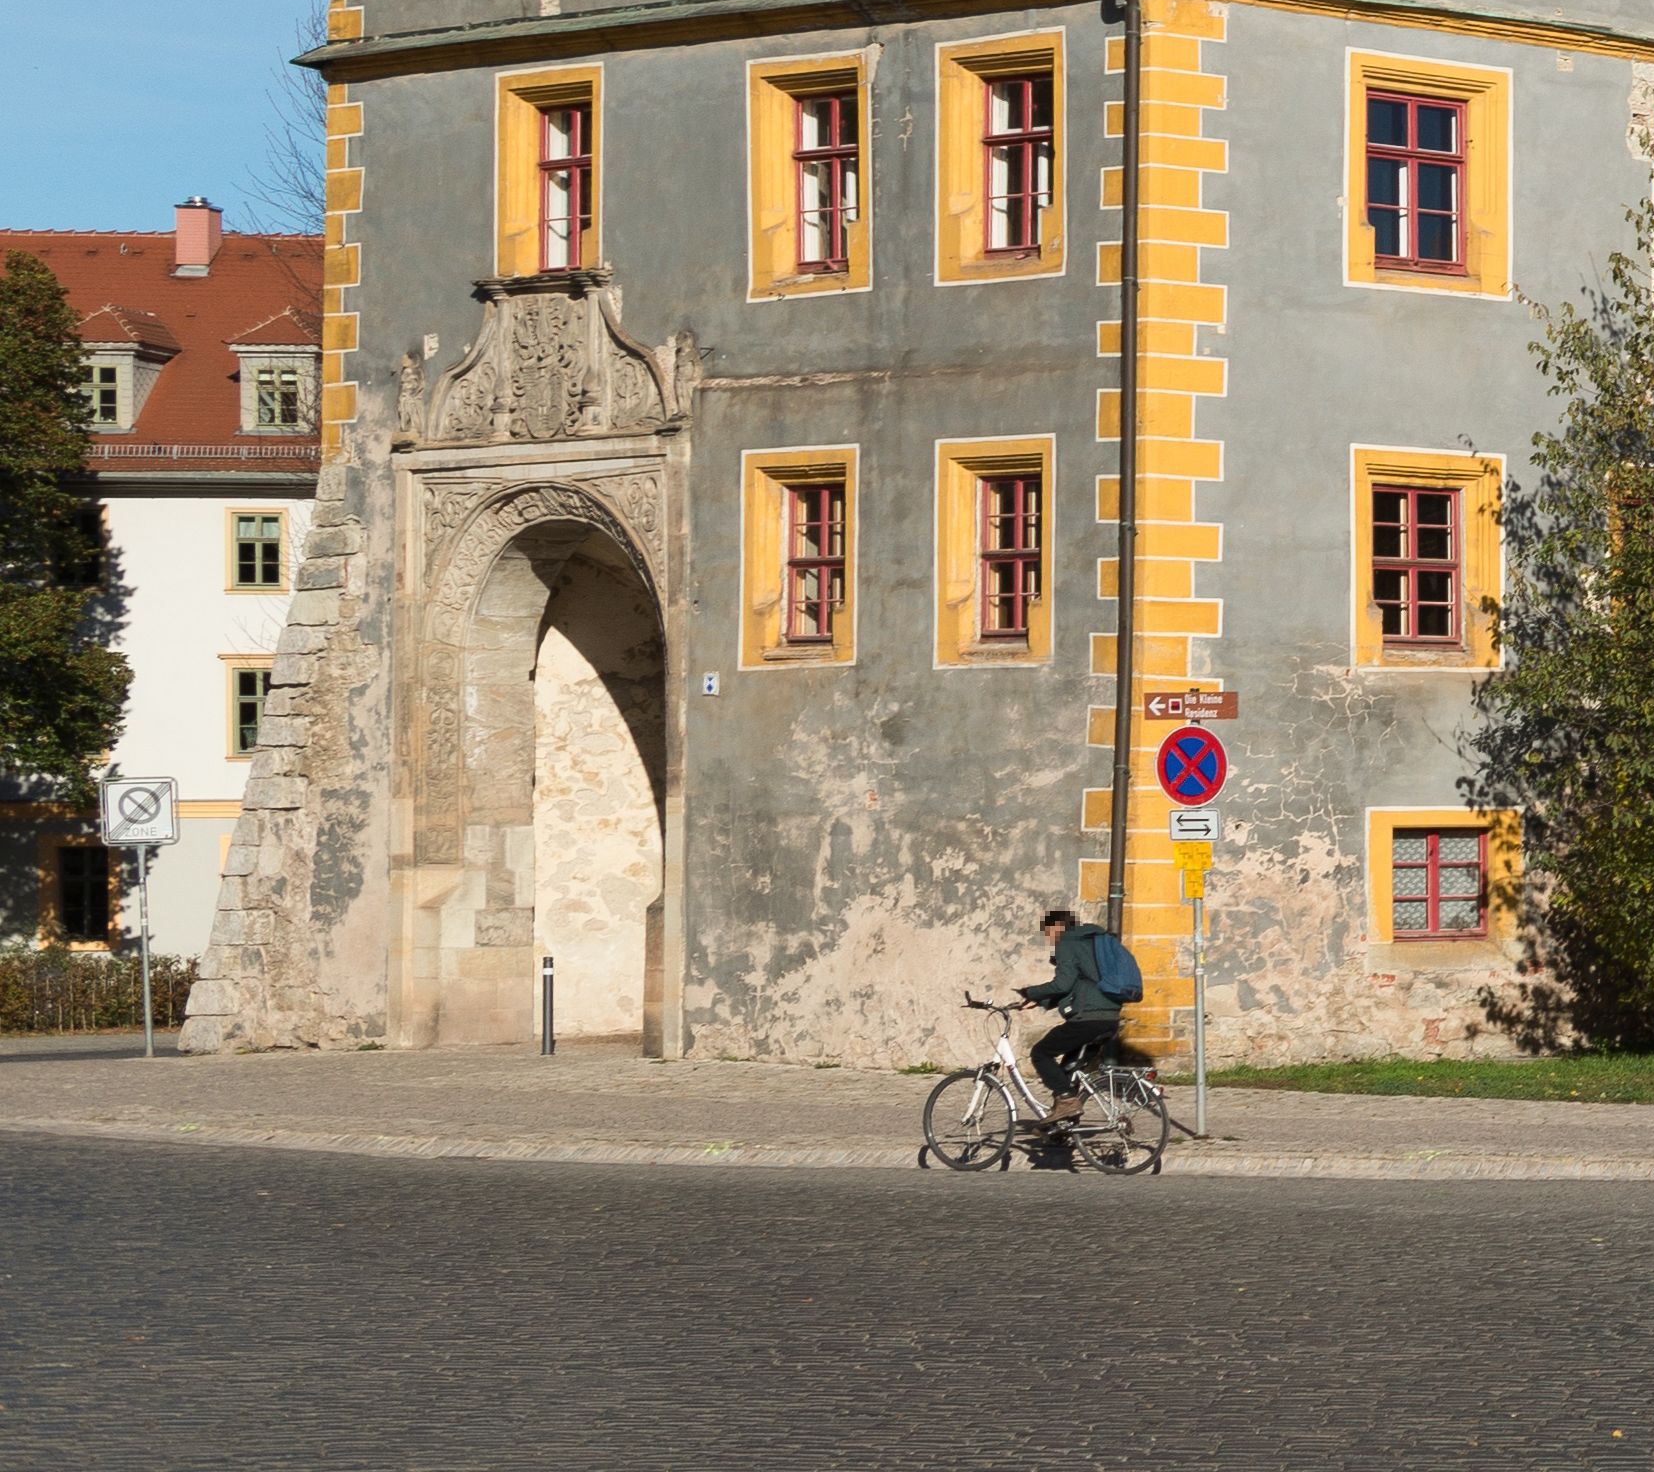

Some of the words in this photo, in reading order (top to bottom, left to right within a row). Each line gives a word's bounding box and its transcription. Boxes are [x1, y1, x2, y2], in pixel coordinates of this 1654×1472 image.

[1184, 694, 1197, 704] Die
[1199, 693, 1223, 704] Kleine
[1184, 707, 1218, 718] Residenz
[124, 827, 158, 836] ZONE
